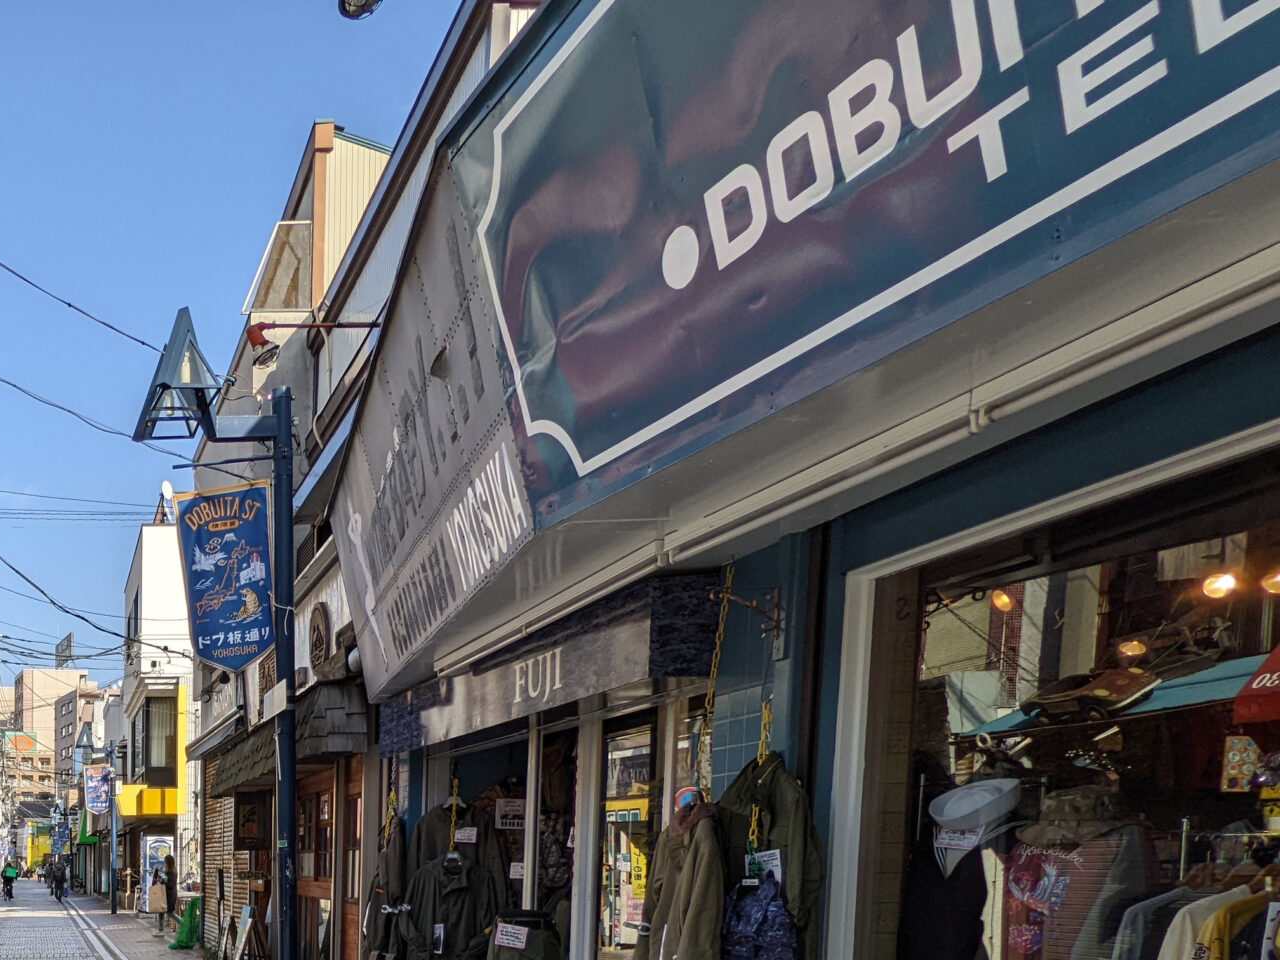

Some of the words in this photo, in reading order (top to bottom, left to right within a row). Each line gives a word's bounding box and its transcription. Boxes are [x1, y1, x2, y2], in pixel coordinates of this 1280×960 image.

[703, 0, 1105, 270] DOBUI
[184, 496, 240, 531] DOBUITA
[241, 499, 261, 521] ST
[446, 442, 528, 592] YOKOSUKA
[198, 626, 270, 649] ドブ板通り
[212, 644, 258, 659] YOKOSUKA
[513, 647, 562, 703] FUJI
